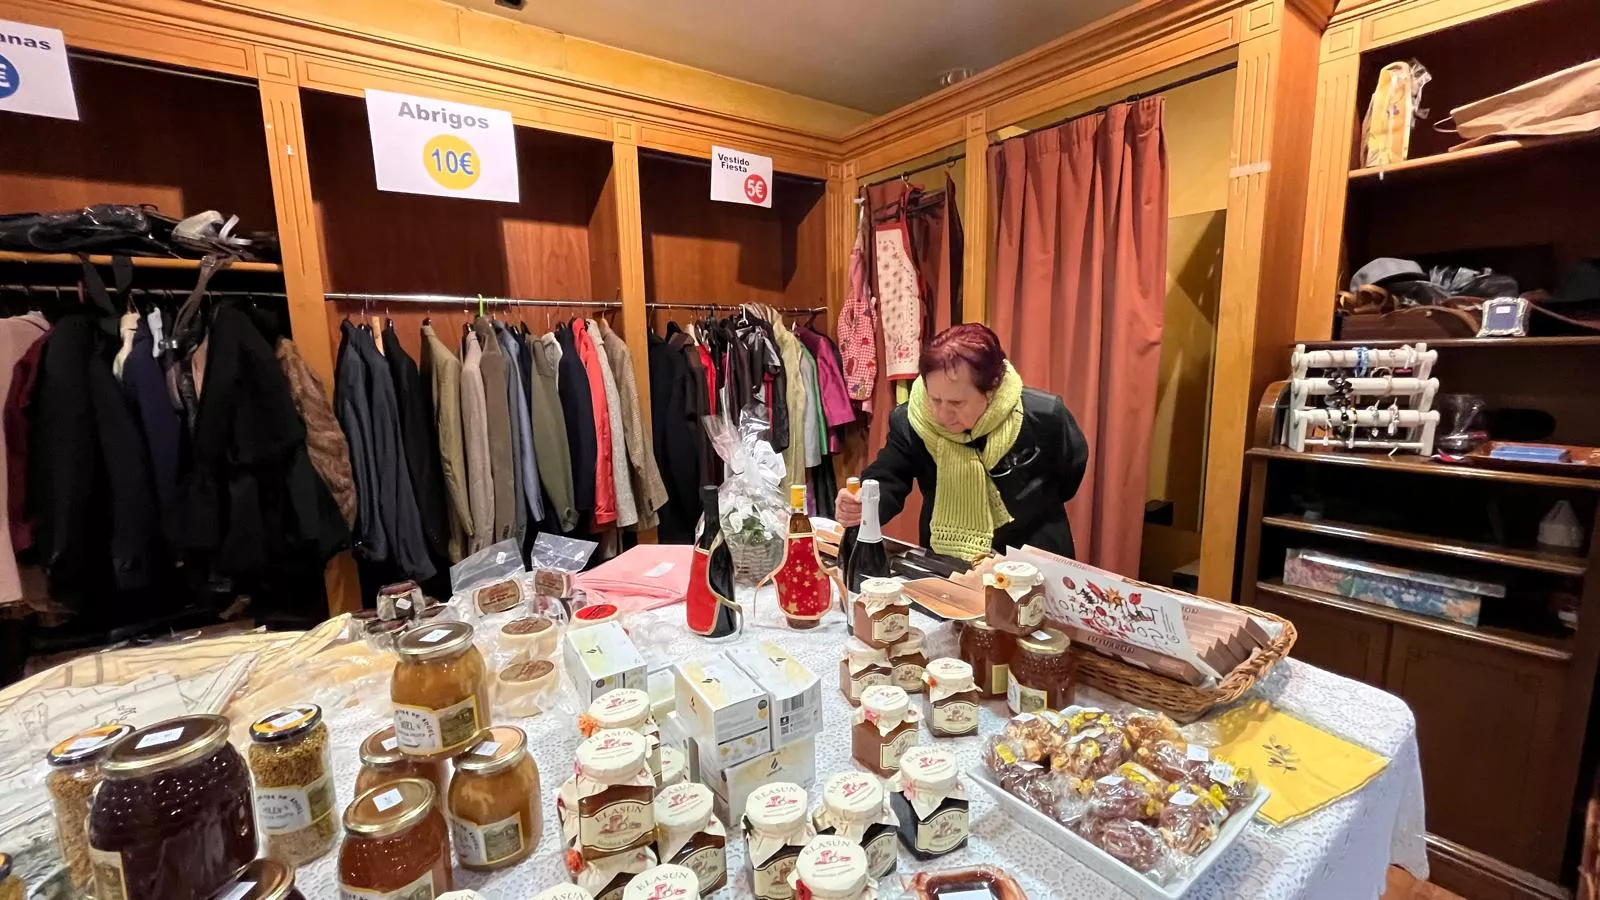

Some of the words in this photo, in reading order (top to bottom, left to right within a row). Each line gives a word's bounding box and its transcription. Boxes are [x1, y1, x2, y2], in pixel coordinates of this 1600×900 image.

[398, 101, 490, 130] Abrigos
[432, 148, 474, 175] 10€
[717, 153, 750, 166] Vestido
[721, 161, 748, 173] Fiesta
[747, 179, 764, 199] 5€
[596, 691, 637, 704] ELASUN
[588, 731, 634, 744] ELASUN
[828, 772, 860, 793] ELASUN
[755, 787, 798, 800] ELASUN
[594, 805, 644, 822] ELASUN
[804, 840, 850, 856] ELASUN
[636, 871, 689, 892] ELASUN
